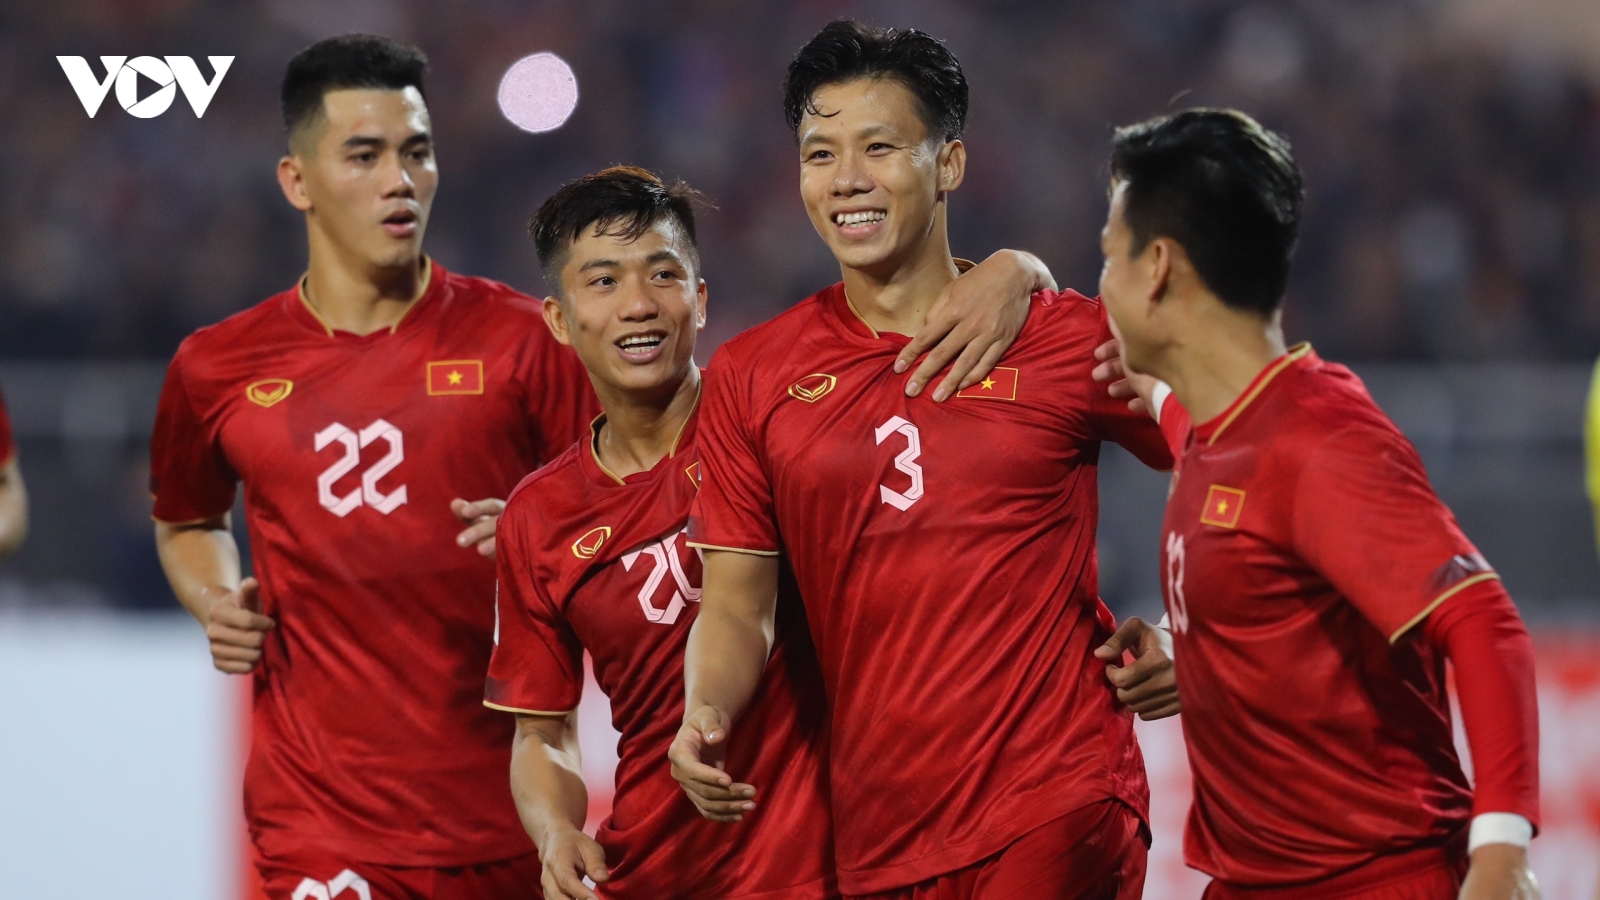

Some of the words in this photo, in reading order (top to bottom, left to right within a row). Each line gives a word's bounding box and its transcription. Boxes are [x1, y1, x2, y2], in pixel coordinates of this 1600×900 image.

[314, 418, 408, 518] 22
[874, 415, 924, 512] 3
[1166, 530, 1189, 635] 13
